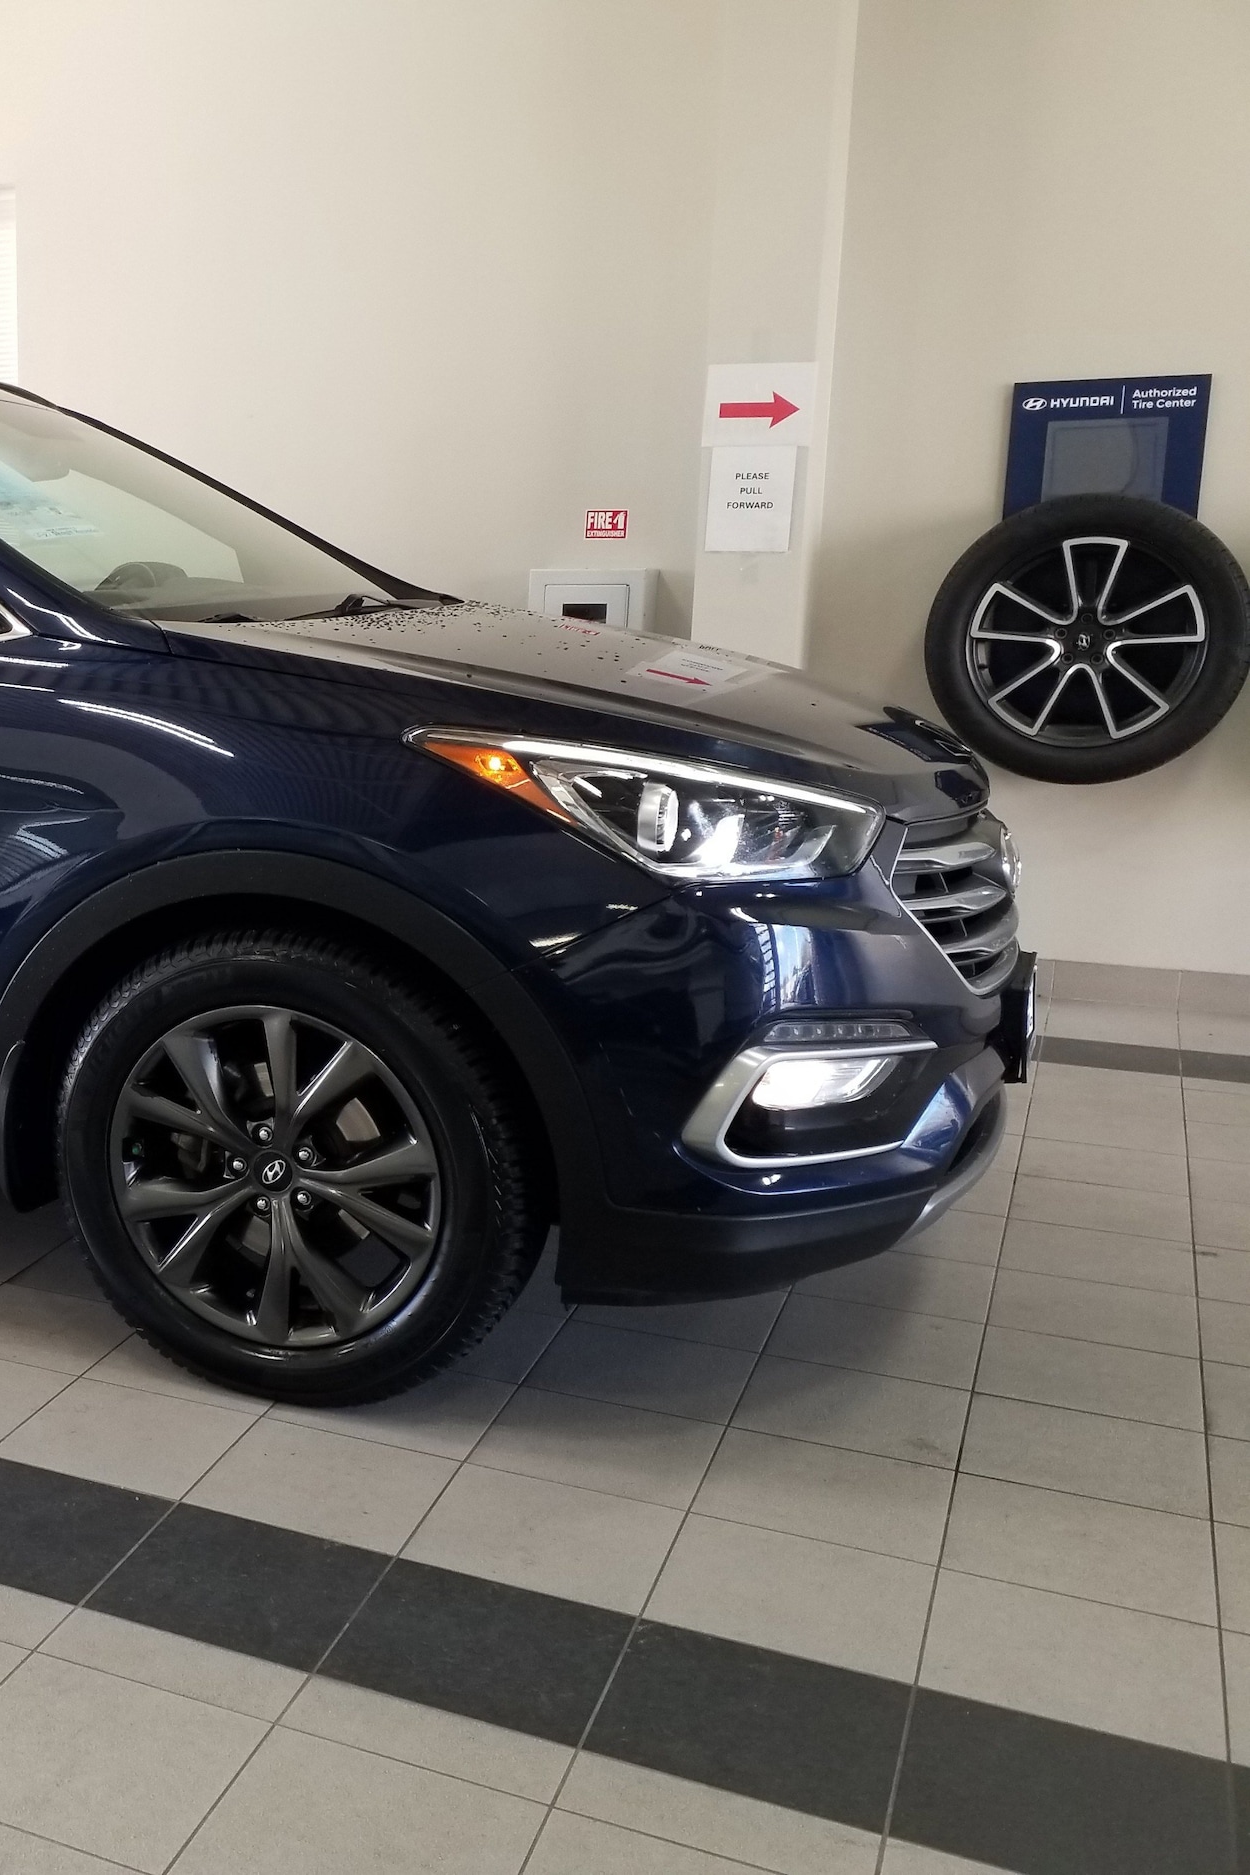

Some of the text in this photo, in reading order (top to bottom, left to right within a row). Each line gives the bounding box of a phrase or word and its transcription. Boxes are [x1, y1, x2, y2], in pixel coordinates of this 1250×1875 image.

[1132, 386, 1197, 398] Authorized
[1050, 396, 1115, 409] HYUNDAI
[1132, 398, 1197, 410] Tire Center
[735, 472, 770, 480] PLEASE
[739, 487, 763, 495] PULL
[726, 501, 774, 509] FORWARD
[587, 511, 614, 530] FIRE
